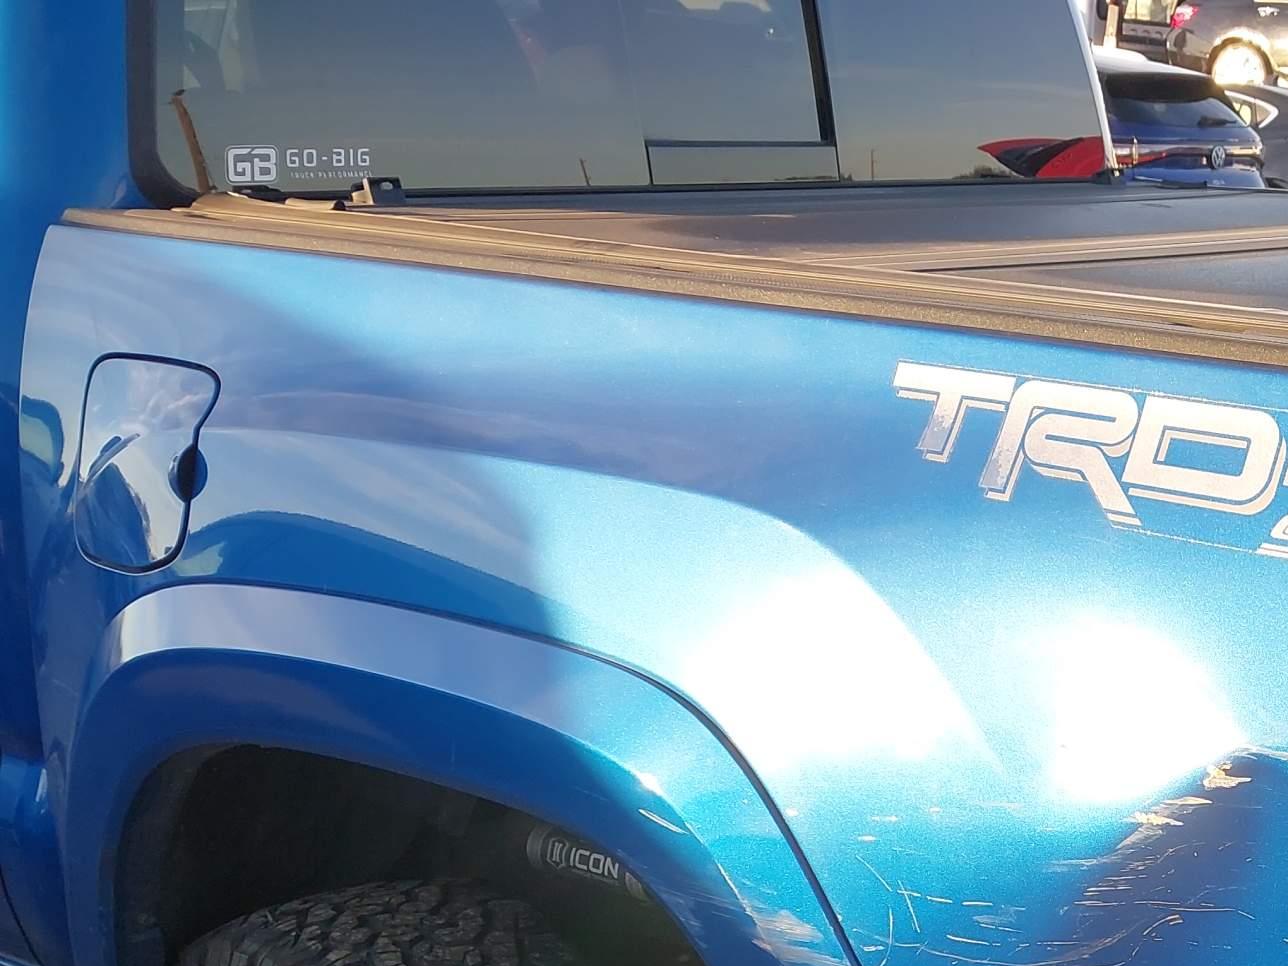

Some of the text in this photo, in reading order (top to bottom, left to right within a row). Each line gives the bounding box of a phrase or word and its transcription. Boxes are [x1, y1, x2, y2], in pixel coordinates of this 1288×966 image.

[227, 148, 370, 182] GB GO-BIG
[892, 360, 1287, 527] TRD
[569, 847, 620, 879] ICON
